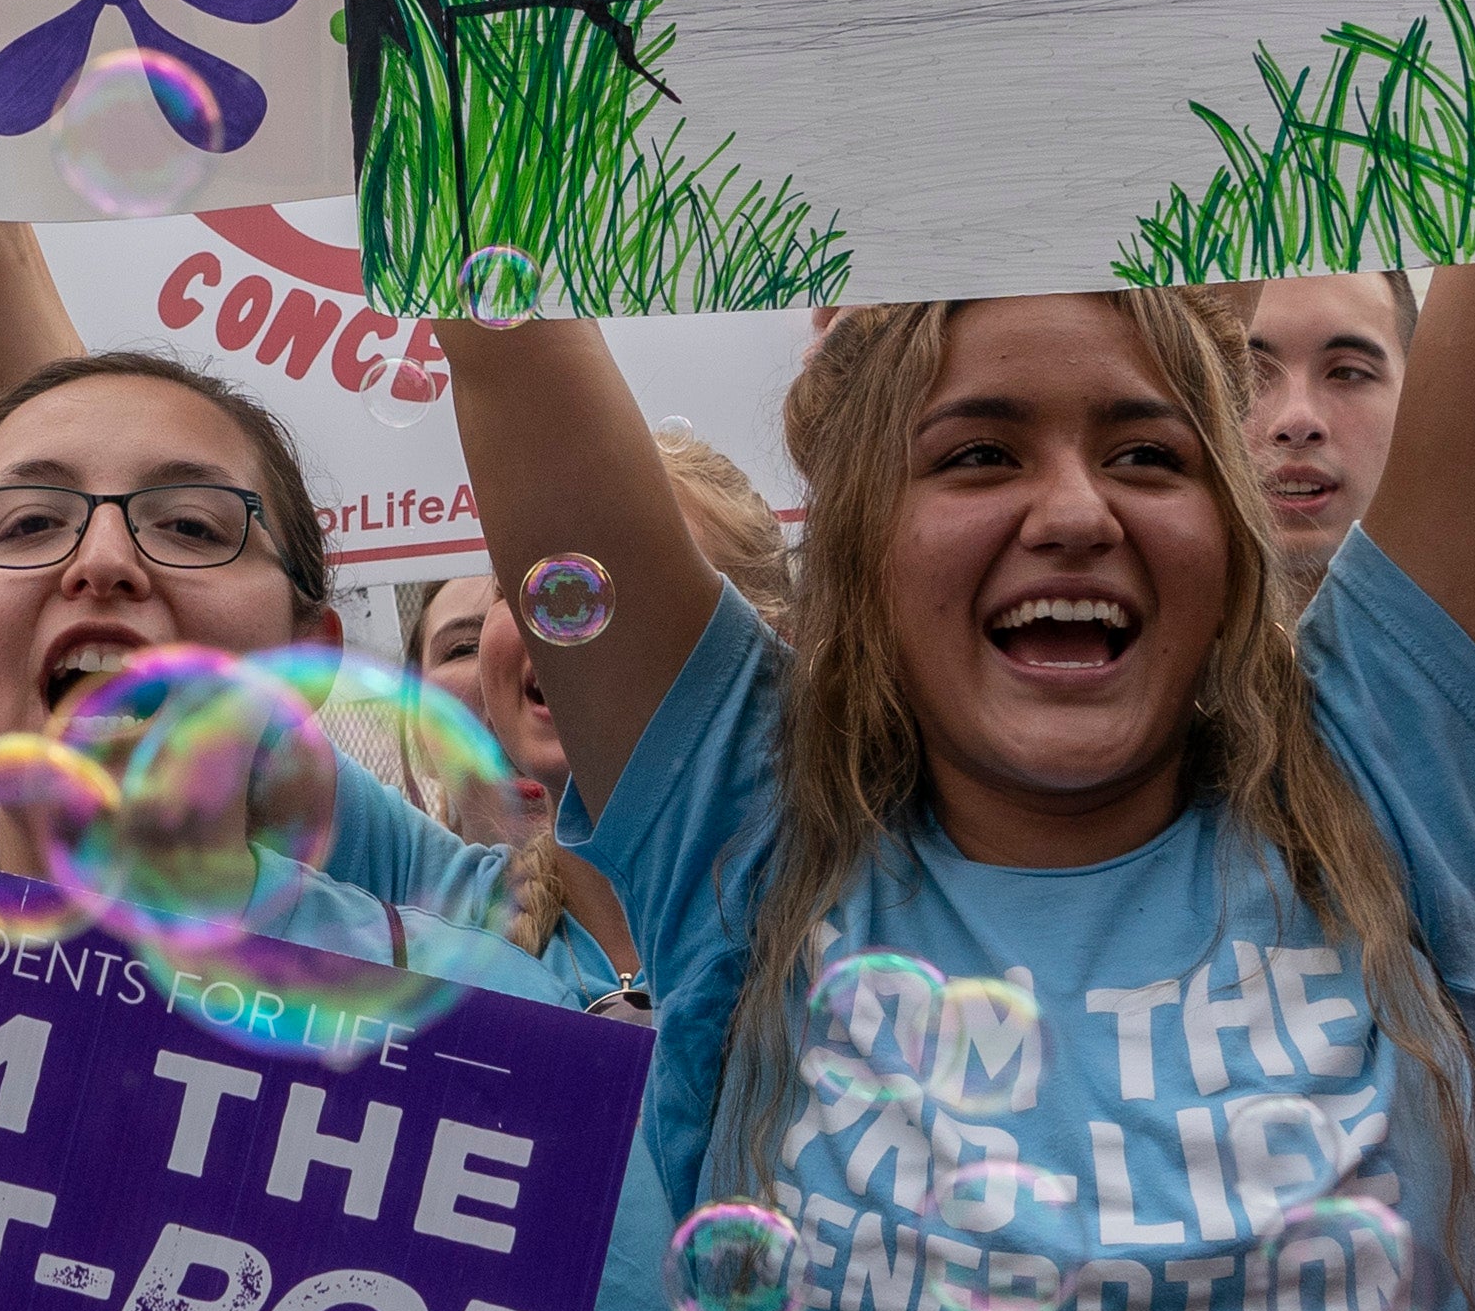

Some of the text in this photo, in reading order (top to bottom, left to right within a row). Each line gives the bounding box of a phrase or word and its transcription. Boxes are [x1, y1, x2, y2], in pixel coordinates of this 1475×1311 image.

[167, 969, 283, 1039] FOR
[302, 1002, 411, 1072] LIFE
[1085, 939, 1366, 1101] THE
[152, 1049, 536, 1254] THE
